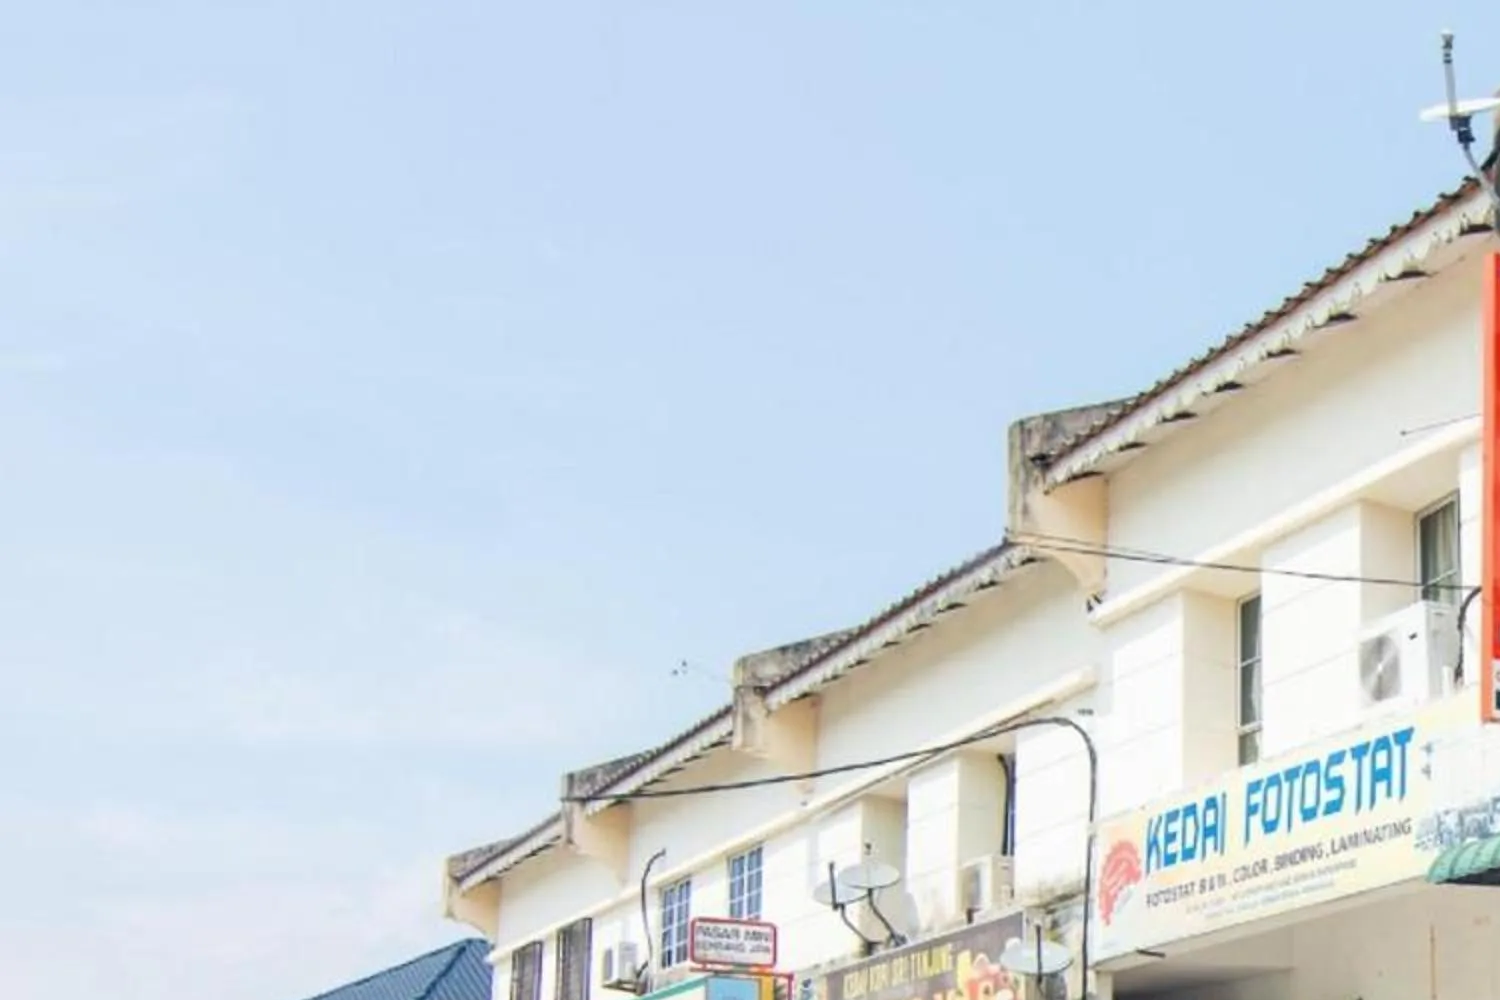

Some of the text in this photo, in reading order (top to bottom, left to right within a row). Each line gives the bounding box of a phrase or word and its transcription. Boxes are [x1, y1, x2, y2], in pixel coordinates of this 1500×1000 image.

[1145, 726, 1415, 879] KEDAI FOTOSTAT
[1331, 818, 1413, 855] LAMINATING
